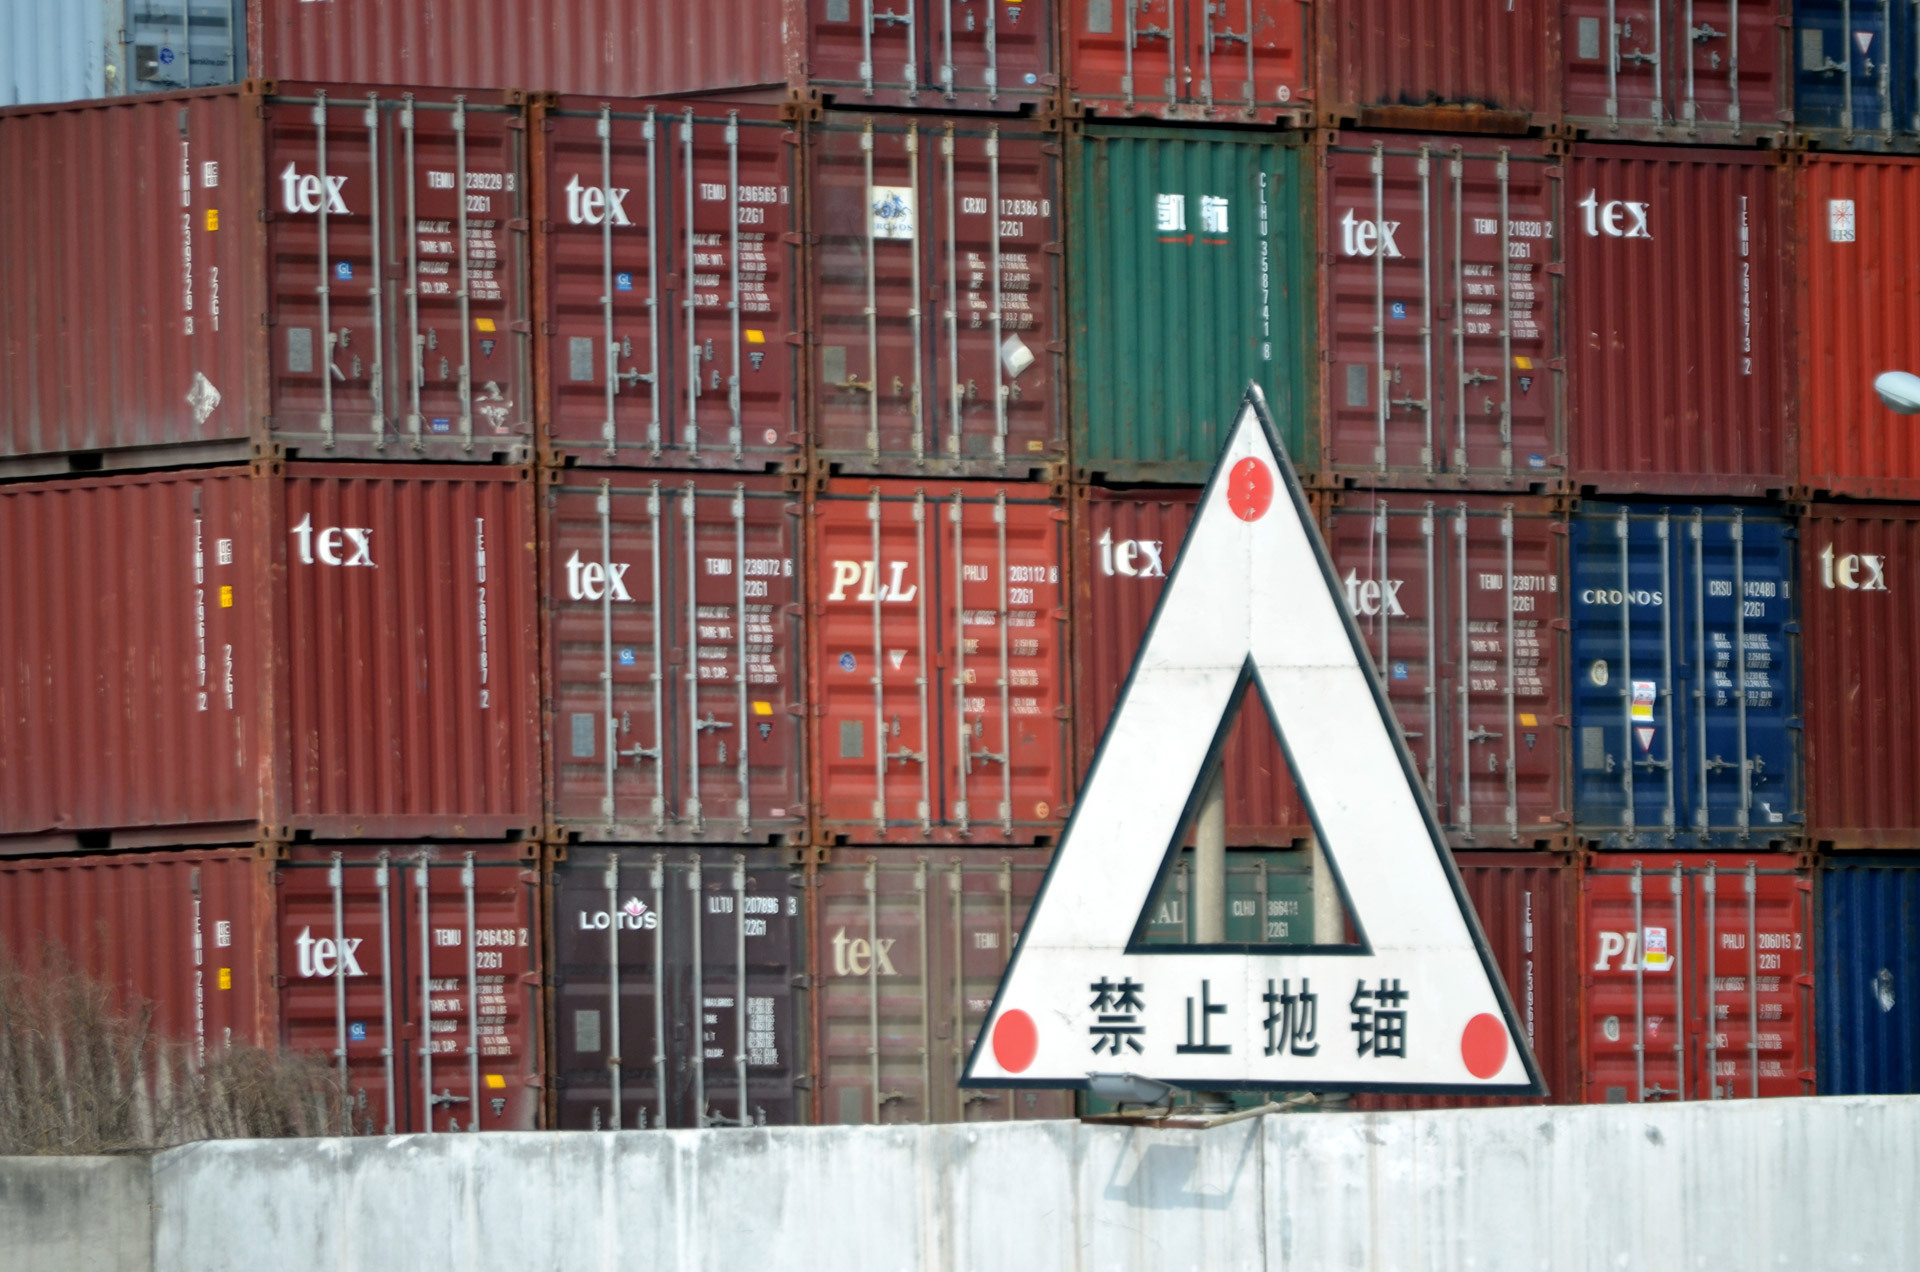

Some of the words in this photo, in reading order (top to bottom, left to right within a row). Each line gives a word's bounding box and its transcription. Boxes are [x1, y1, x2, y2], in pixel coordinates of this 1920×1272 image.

[182, 142, 190, 206] TEMU
[428, 172, 455, 188] TEMU
[467, 173, 502, 190] 239229
[506, 174, 514, 191] 3
[281, 161, 350, 213] tex
[701, 184, 726, 200] TEMU
[739, 186, 776, 202] 296565
[781, 187, 789, 203] 1
[466, 195, 490, 212] 22G1
[566, 174, 632, 225] tex
[963, 198, 987, 214] CRXU
[1001, 200, 1037, 215] 128386
[1042, 201, 1050, 217] 0
[1260, 172, 1268, 235] CLHU
[739, 208, 764, 224] 22G1
[1580, 189, 1651, 237] tex
[1001, 222, 1023, 236] 22G1
[1342, 208, 1402, 257] tex
[1475, 219, 1497, 234] TEMU
[1509, 221, 1541, 237] 219320
[1545, 221, 1553, 238] 2
[1832, 229, 1854, 241] HRS
[1509, 243, 1531, 257] 22G1
[183, 213, 192, 310] 239229
[338, 263, 352, 274] GL
[618, 274, 632, 284] GL
[1261, 241, 1269, 336] 358741
[1467, 284, 1483, 295] TARE
[211, 267, 219, 331] 22G1
[1392, 303, 1405, 314] GL
[185, 316, 194, 335] 3
[1264, 343, 1271, 360] 8
[1744, 357, 1752, 375] 2
[291, 512, 376, 566] tex
[1100, 528, 1165, 577] tex
[706, 558, 731, 575] TEMU
[745, 559, 780, 576] 239072
[784, 559, 793, 577] 6
[964, 565, 988, 581] PHLU
[1010, 566, 1045, 583] 203112
[1049, 566, 1058, 583] 8
[1822, 542, 1887, 590] tex
[566, 550, 632, 601] tex
[827, 561, 917, 602] PLL
[1480, 574, 1503, 589] TEMU
[1513, 576, 1545, 591] 239711
[1549, 575, 1558, 592] 9
[745, 581, 767, 597] 22G1
[1010, 589, 1033, 604] 22G1
[1345, 568, 1405, 616] tex
[1583, 590, 1663, 605] CRONOS
[1711, 581, 1732, 596] CRSU
[1744, 582, 1775, 597] 142480
[1784, 581, 1790, 598] 1
[1513, 597, 1534, 612] 22G1
[1744, 602, 1765, 617] 22G1
[225, 644, 233, 709] 22G1
[198, 691, 207, 711] 2
[480, 690, 490, 708] 2
[709, 896, 733, 913] LLTU
[745, 897, 779, 914] 207896
[788, 897, 798, 916] 3
[1233, 901, 1255, 916] CLHU
[579, 912, 657, 930] LOTUS
[745, 920, 766, 936] 22G1
[1269, 922, 1288, 937] 22G1
[193, 900, 202, 965] TEMU
[434, 929, 461, 946] TEMU
[476, 930, 515, 946] 296436
[519, 928, 528, 947] 2
[974, 933, 999, 948] TEMU
[1723, 934, 1745, 949] PHLU
[1760, 934, 1791, 949] 206015
[1795, 934, 1802, 949] 2
[296, 926, 364, 977] tex
[833, 926, 898, 975] tex
[477, 952, 502, 969] 22G1
[1760, 955, 1780, 969] 22G1
[1089, 977, 1410, 1059] 禁止抛锚
[352, 1024, 365, 1035] GL
